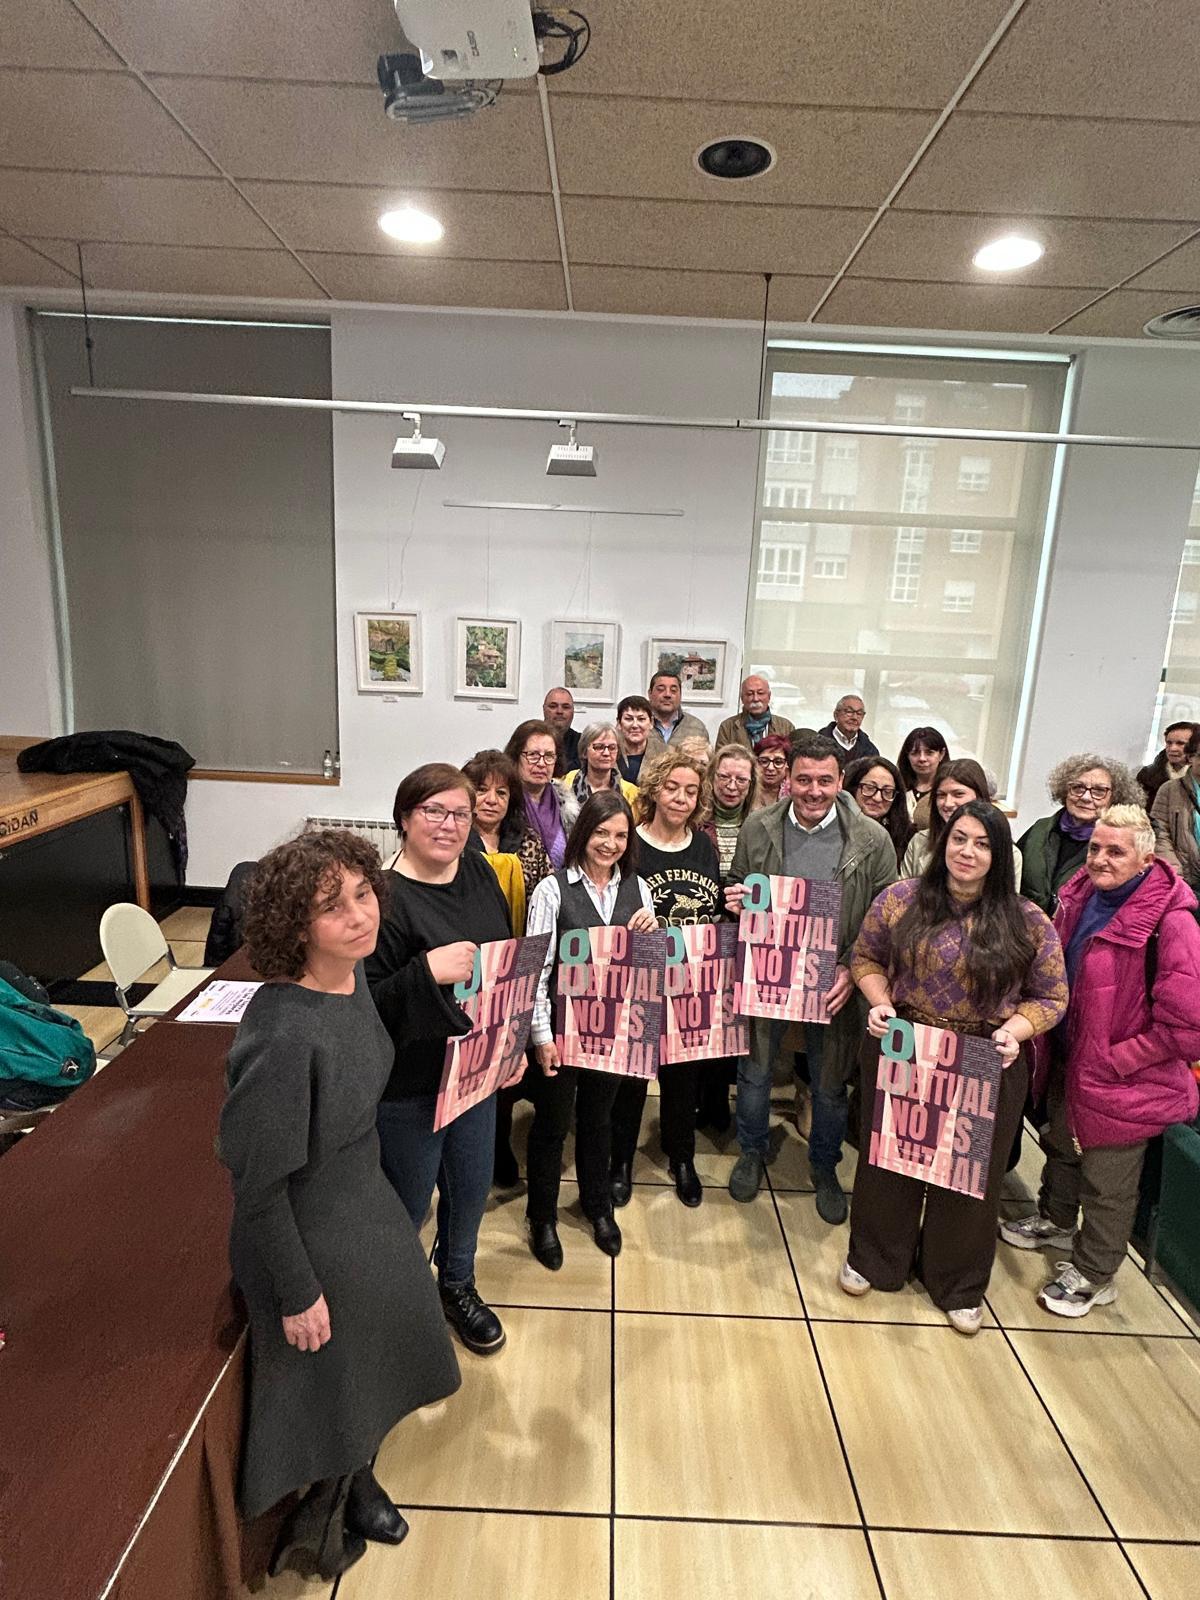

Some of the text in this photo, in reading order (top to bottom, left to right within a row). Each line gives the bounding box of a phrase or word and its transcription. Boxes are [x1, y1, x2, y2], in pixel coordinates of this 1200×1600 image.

[665, 869, 719, 899] FEMENIN
[777, 877, 806, 911] LO
[597, 926, 628, 961] LO
[690, 923, 717, 957] LO
[738, 910, 837, 950] HABITUAL
[487, 939, 517, 978] LO
[752, 947, 783, 983] NO
[790, 951, 820, 987] ES
[557, 963, 662, 1003] HABITUAL
[573, 999, 606, 1034] NO
[614, 1003, 645, 1039] ES
[672, 996, 702, 1029] NO
[710, 993, 736, 1024] ES
[460, 1020, 520, 1078] NO ES
[922, 1027, 958, 1067] LO
[876, 1056, 995, 1120] HABITUAL
[891, 1098, 928, 1141] NO
[936, 1111, 973, 1154] ES
